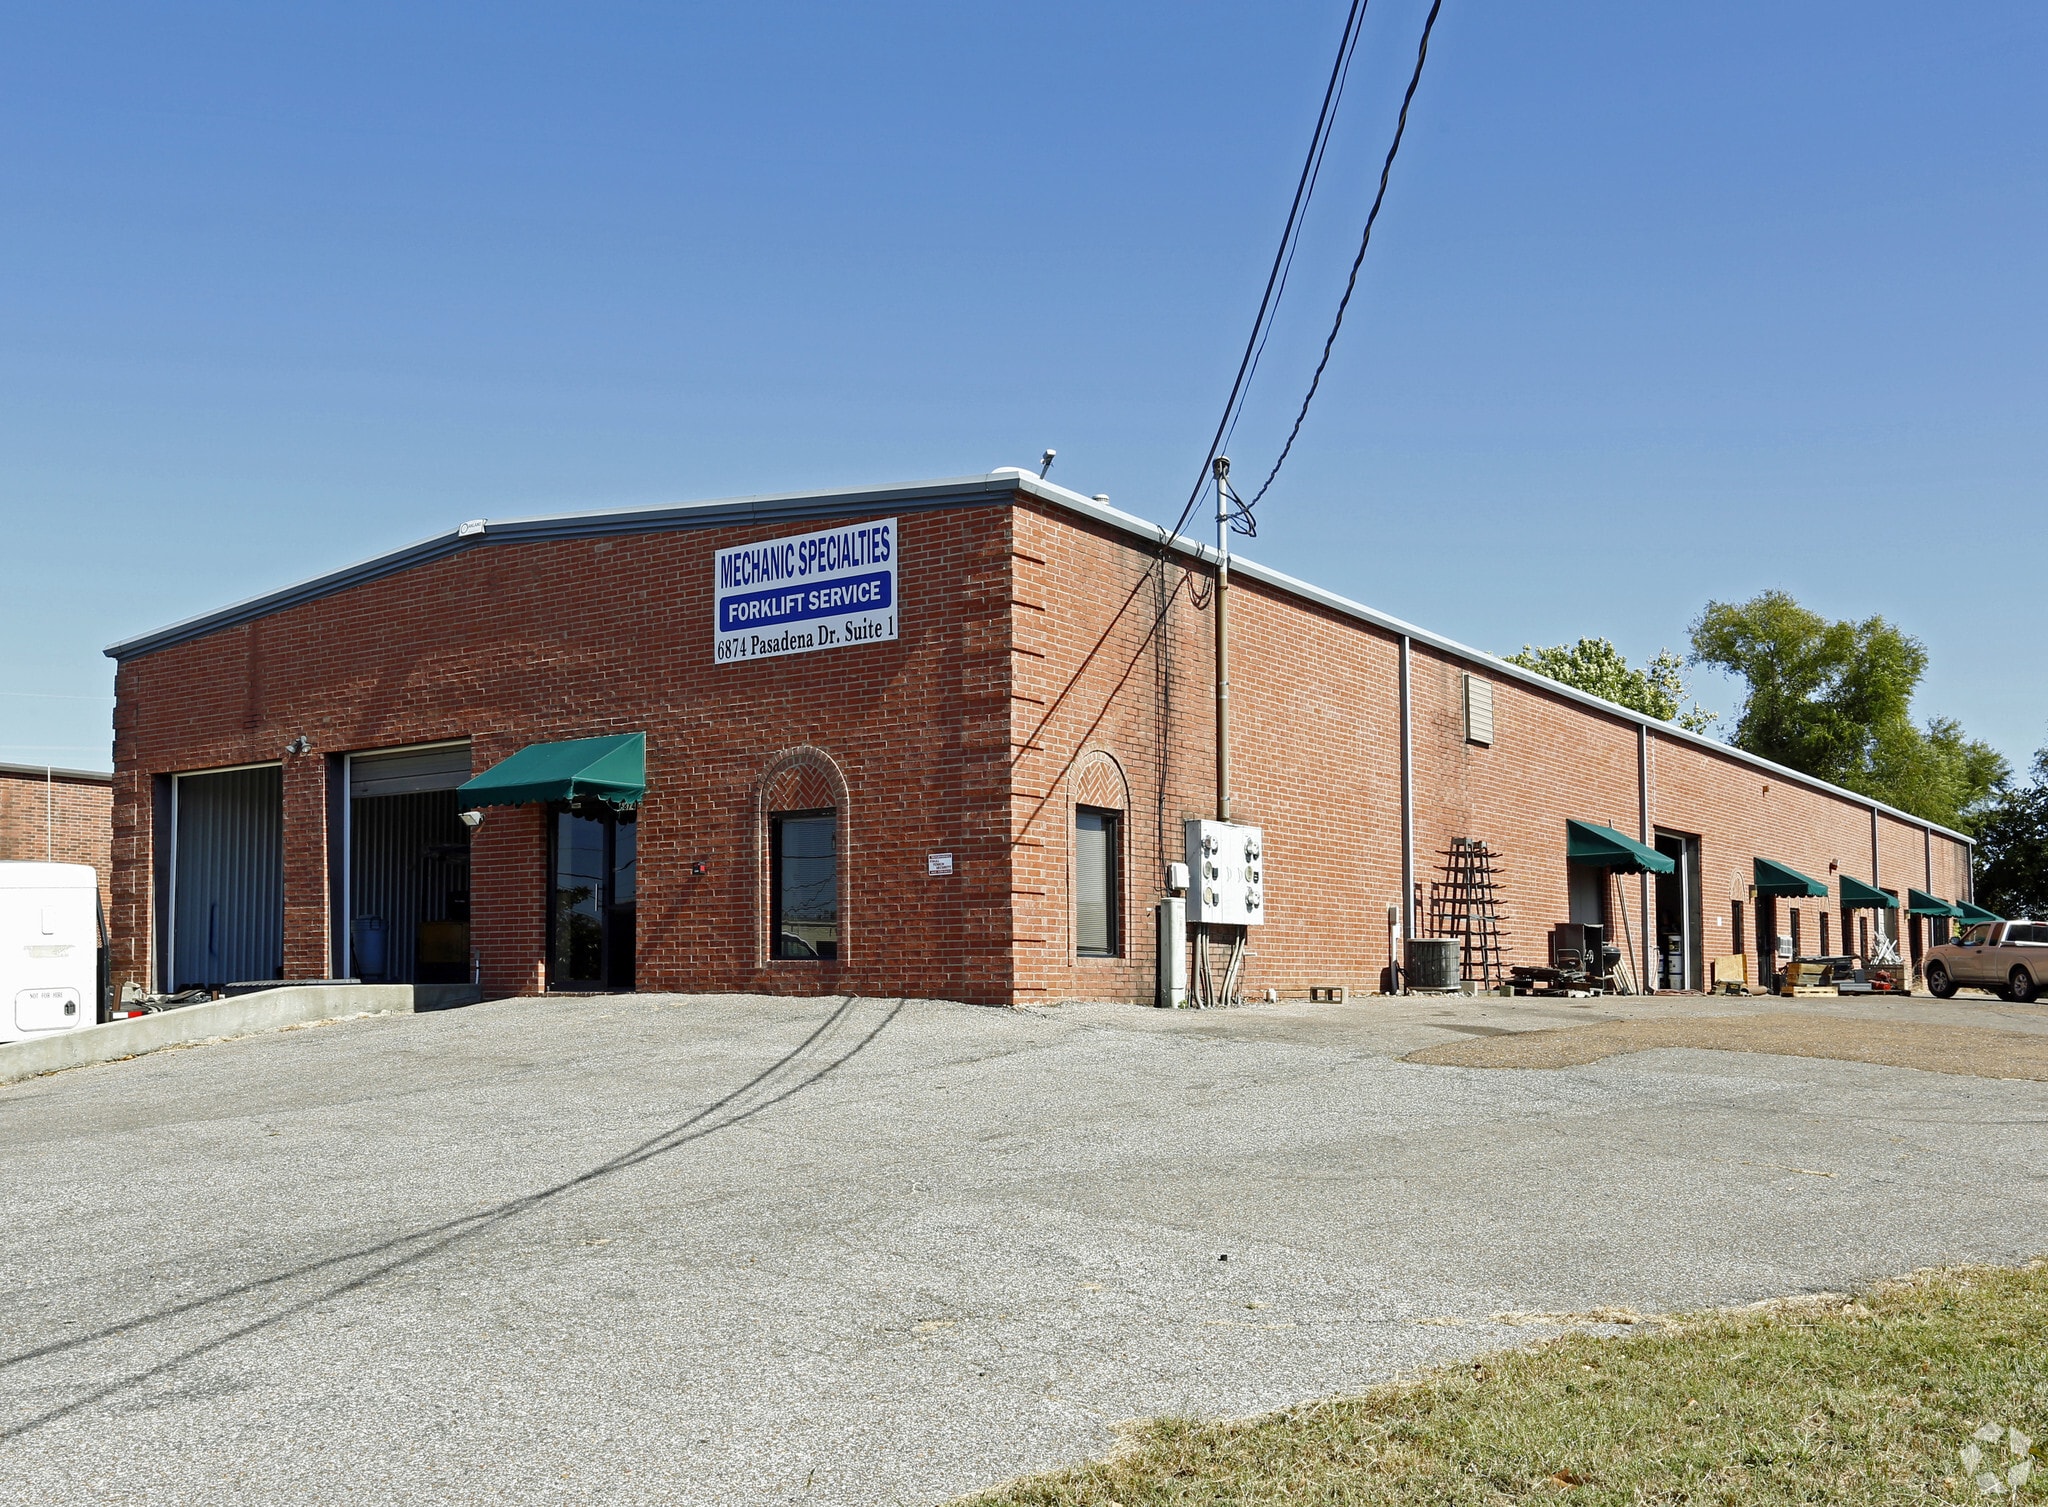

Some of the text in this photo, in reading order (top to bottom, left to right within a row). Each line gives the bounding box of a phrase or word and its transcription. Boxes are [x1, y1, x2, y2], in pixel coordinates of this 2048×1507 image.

[721, 525, 890, 589] MECHANIC SPECIALTIES
[728, 580, 881, 623] FORKLIFT SERVICE
[717, 615, 894, 660] 6874 Pasadena Dr. Suite 1
